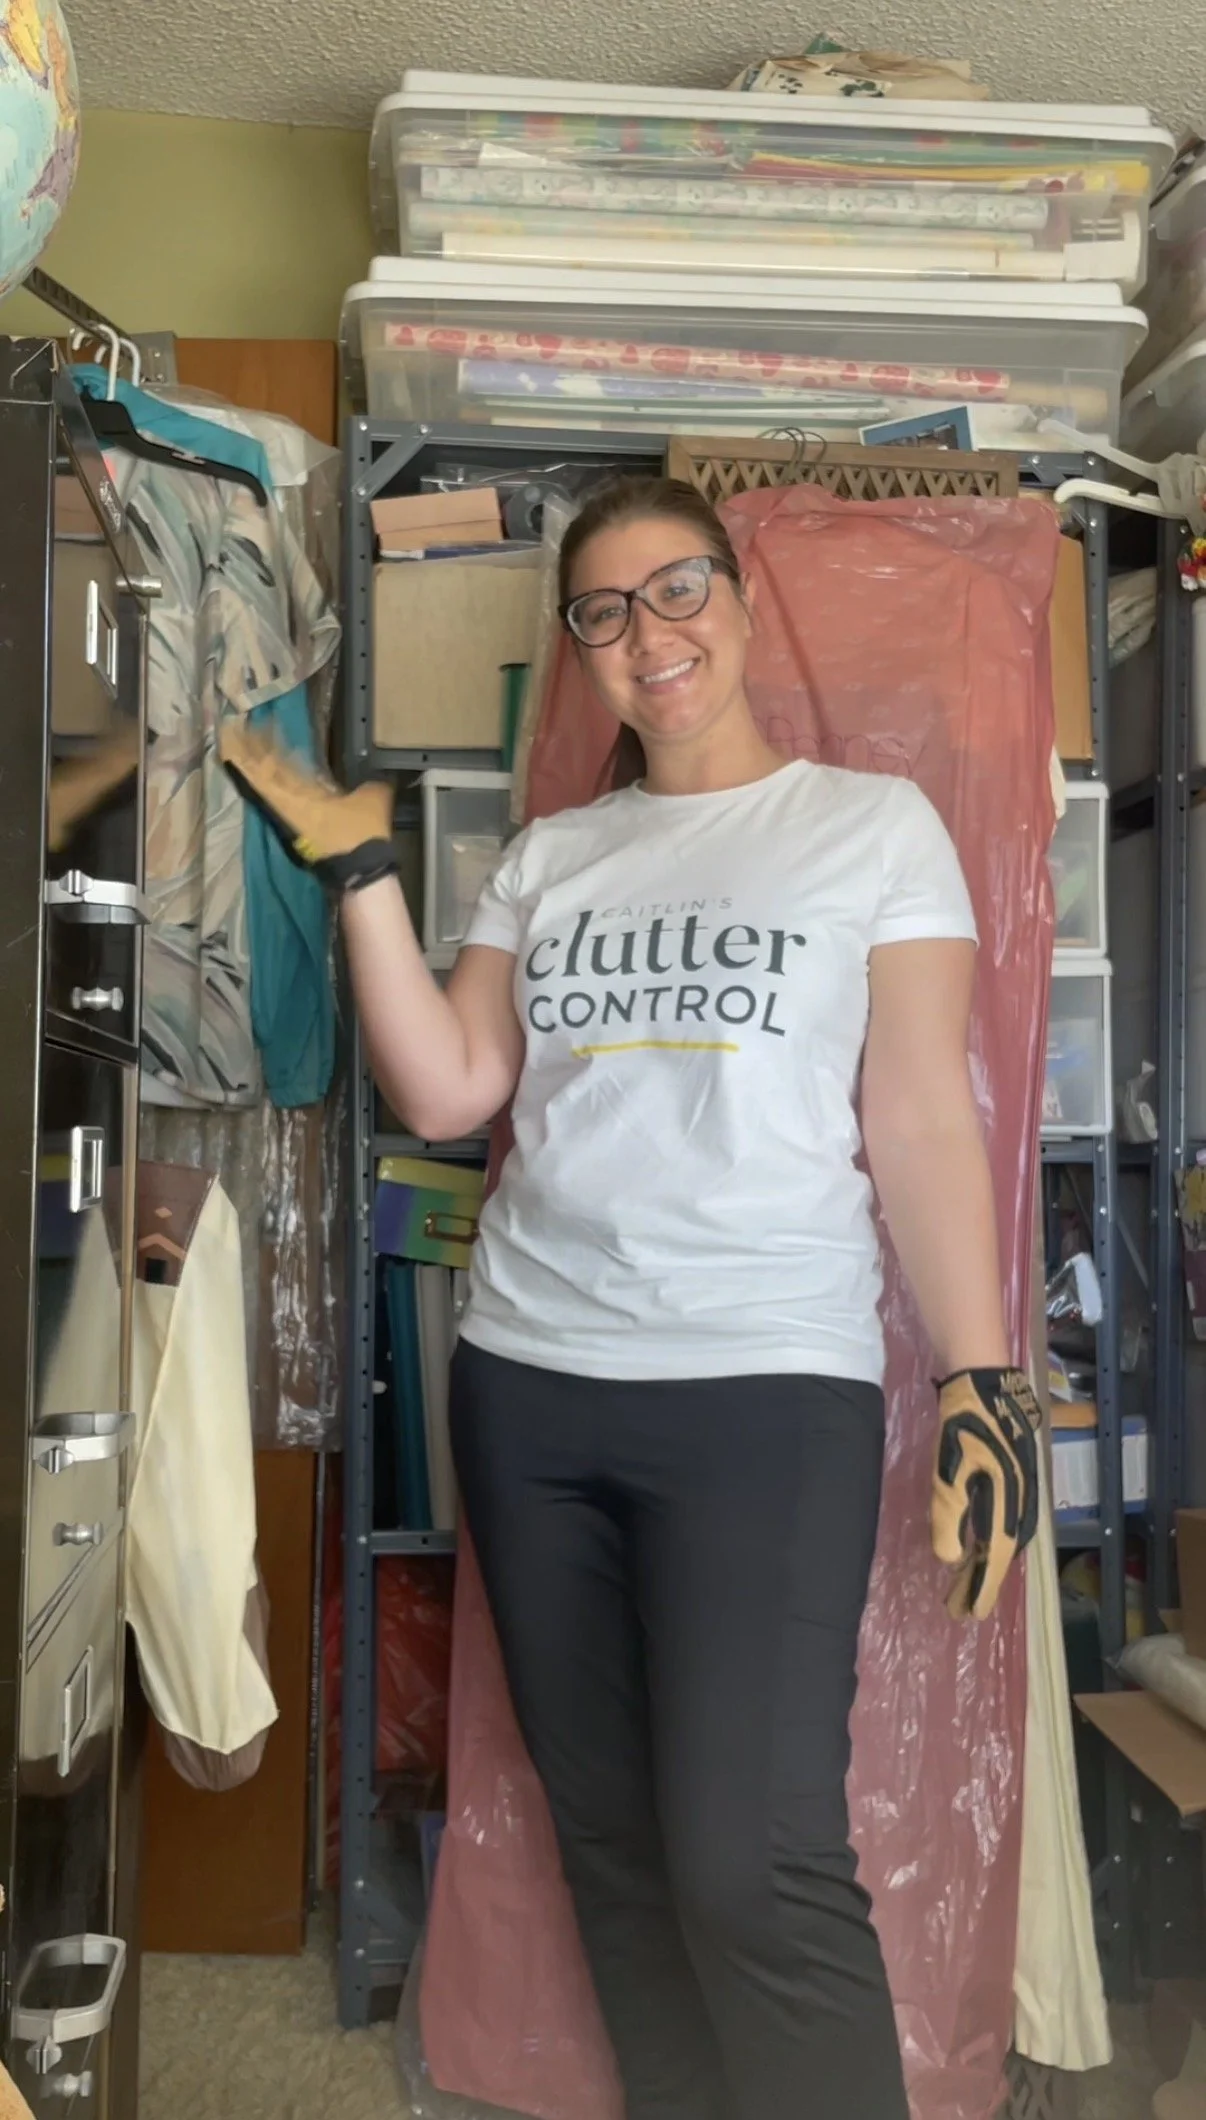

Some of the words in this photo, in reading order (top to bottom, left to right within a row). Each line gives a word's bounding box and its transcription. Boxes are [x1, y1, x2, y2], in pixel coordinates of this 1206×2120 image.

[601, 897, 733, 919] CAITLIN'S
[525, 910, 807, 982] clutter
[528, 984, 786, 1037] CONTROL
